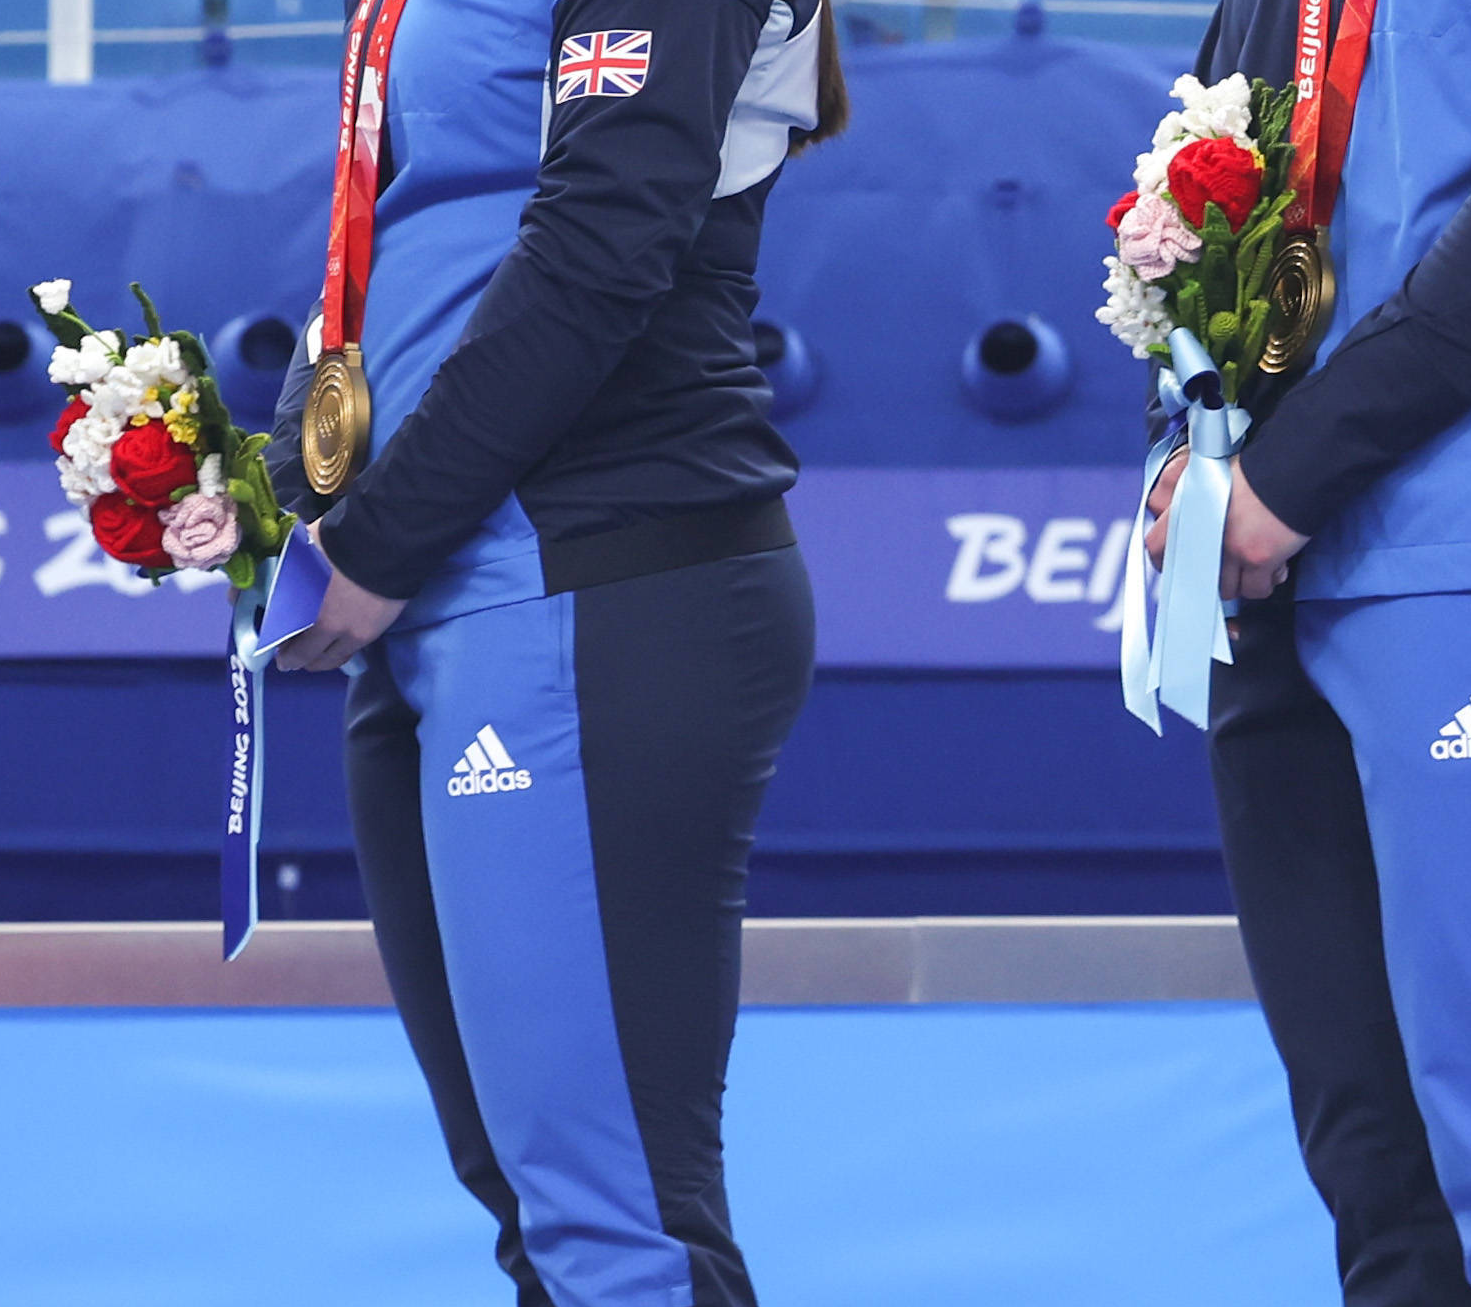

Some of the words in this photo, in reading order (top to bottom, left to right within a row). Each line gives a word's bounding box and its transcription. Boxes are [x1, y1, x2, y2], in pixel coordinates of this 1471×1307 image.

[340, 31, 362, 152] BEIJING
[230, 653, 250, 725] 2022
[228, 732, 250, 835] BEIJING
[447, 765, 532, 797] adidas
